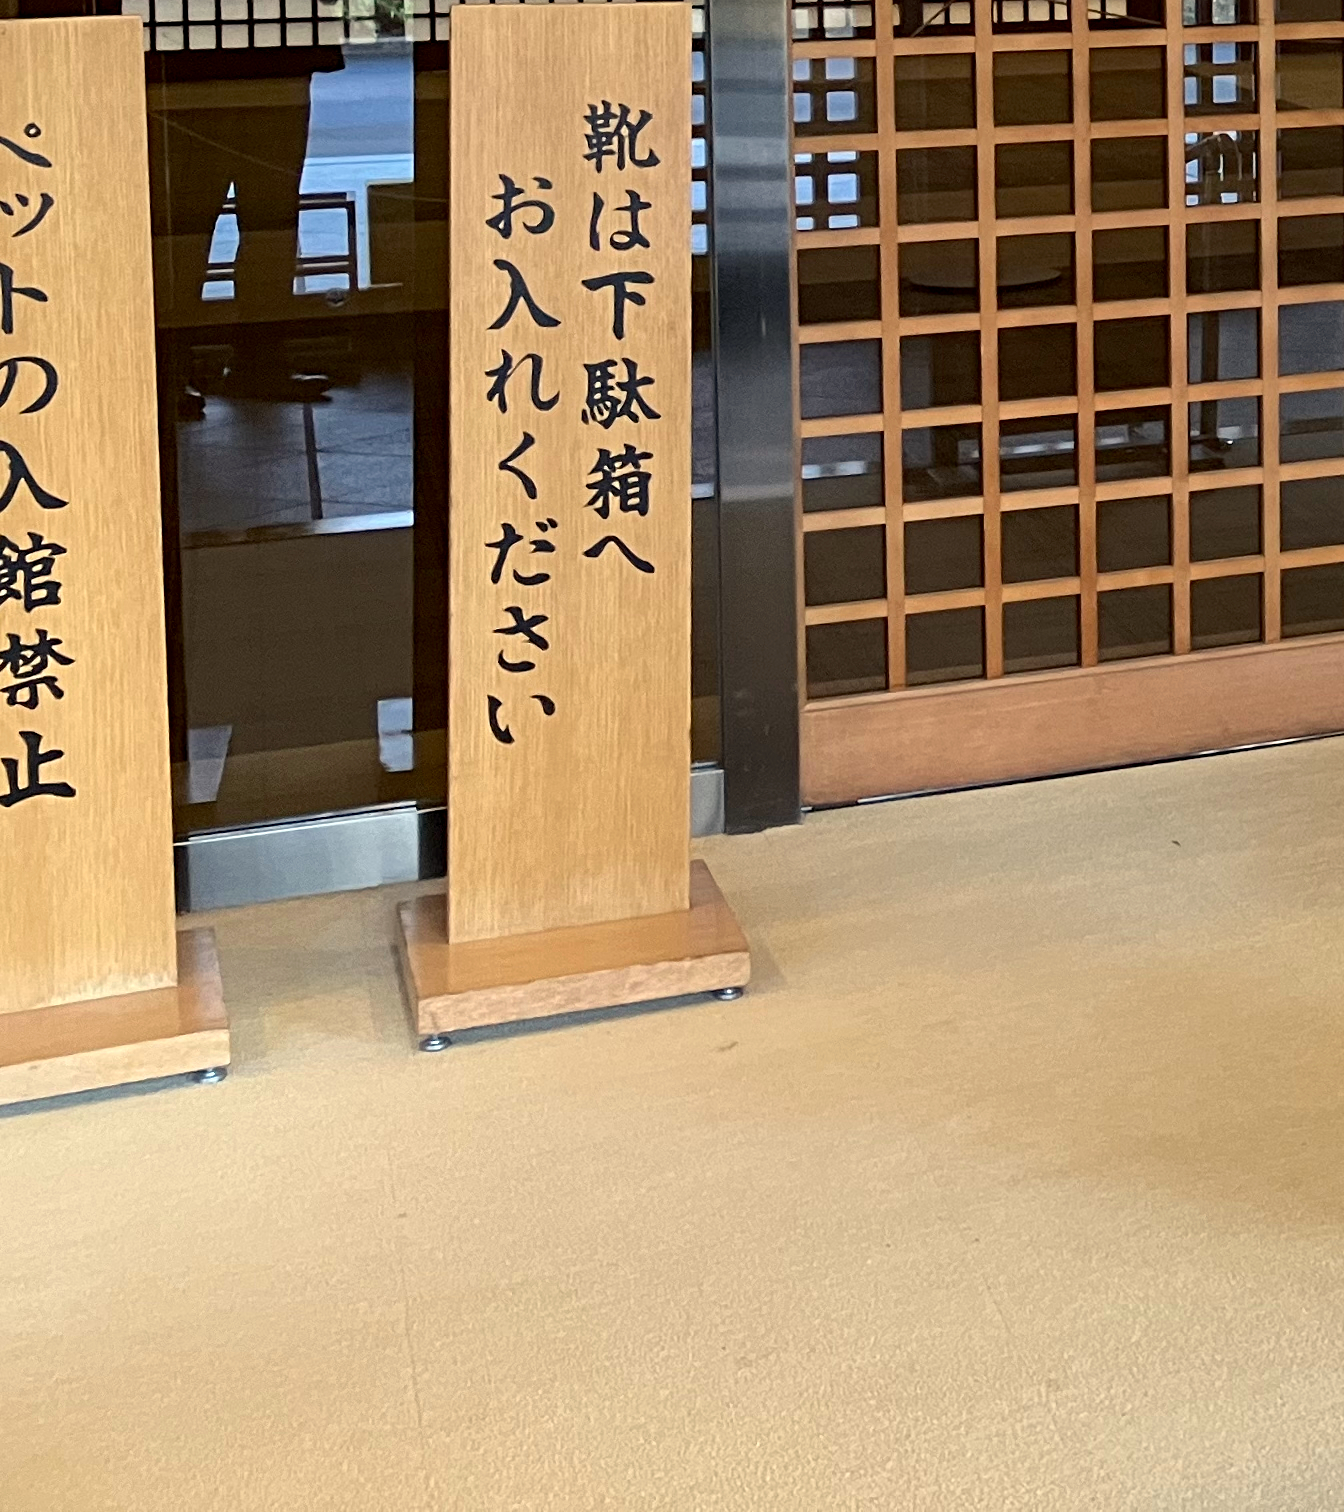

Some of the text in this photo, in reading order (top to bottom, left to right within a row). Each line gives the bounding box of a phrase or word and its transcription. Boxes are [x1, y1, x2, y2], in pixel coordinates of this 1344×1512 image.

[485, 174, 560, 746] お入れください
[581, 99, 662, 577] 靴は下駄箱へ
